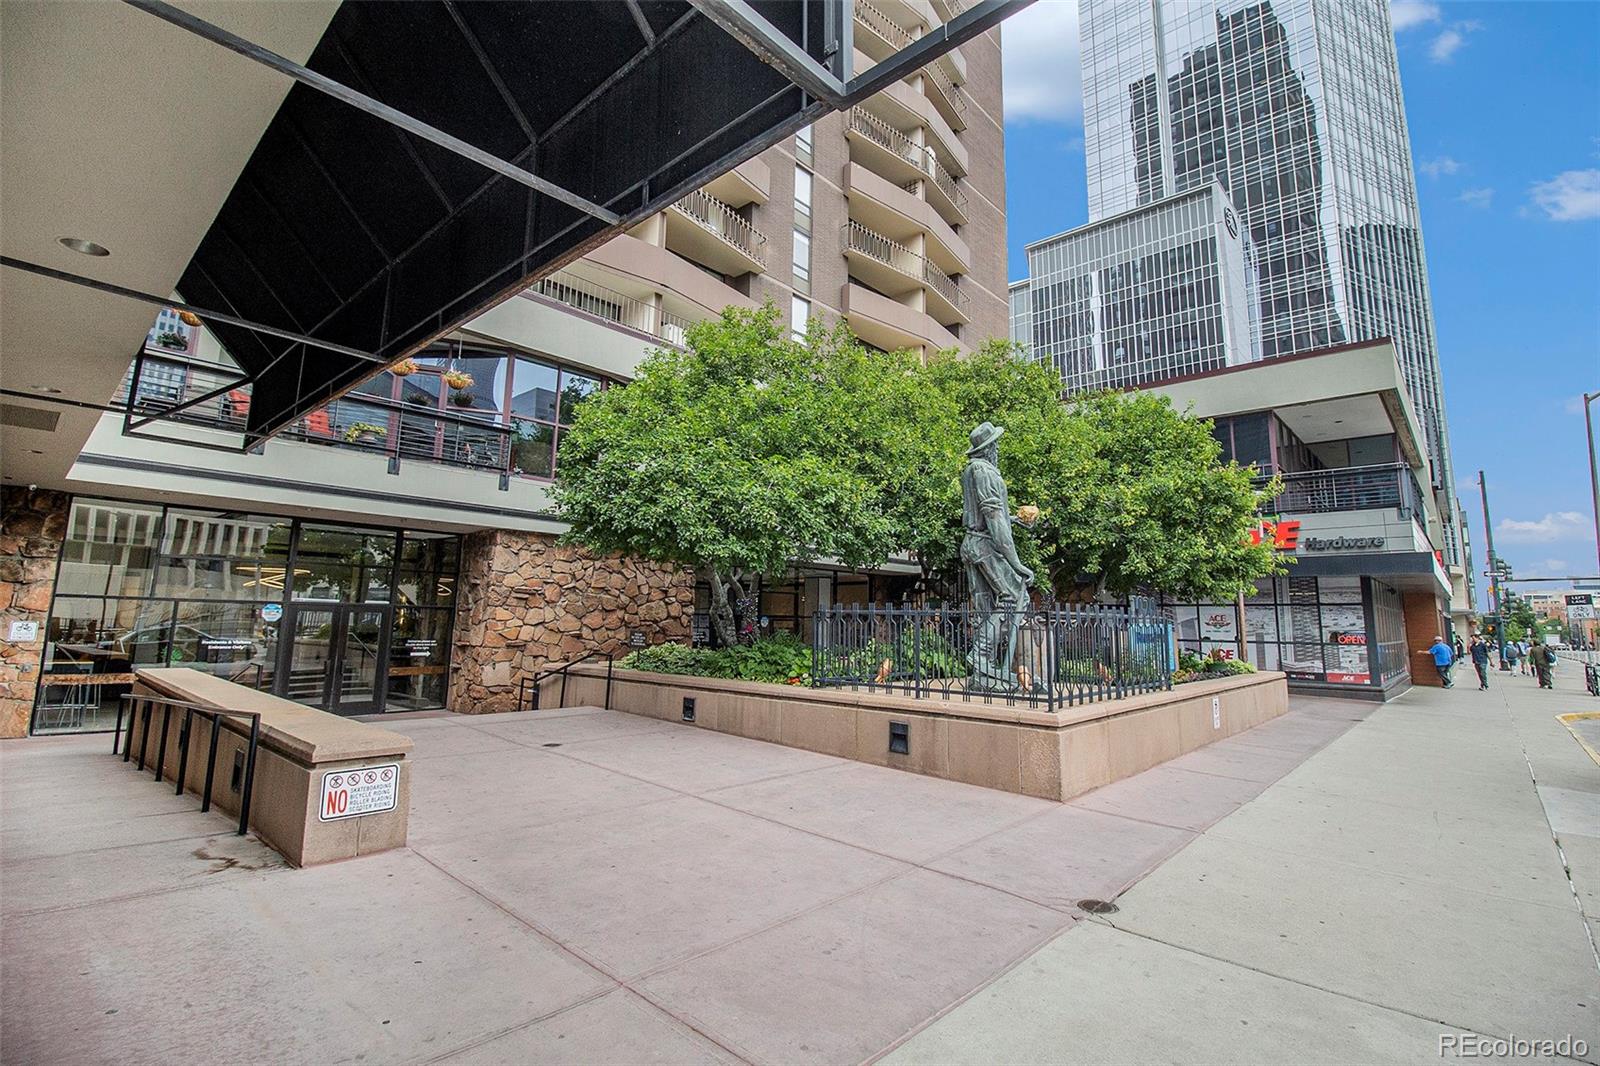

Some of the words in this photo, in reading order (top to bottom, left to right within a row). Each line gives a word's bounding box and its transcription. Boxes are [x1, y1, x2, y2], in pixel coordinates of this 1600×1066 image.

[1304, 536, 1385, 550] Hardware
[1338, 633, 1366, 644] OPEN
[350, 782, 392, 793] SKATEBOARDING
[350, 792, 371, 800] BICYCLE
[326, 789, 347, 815] NO
[349, 798, 370, 806] ROLLER
